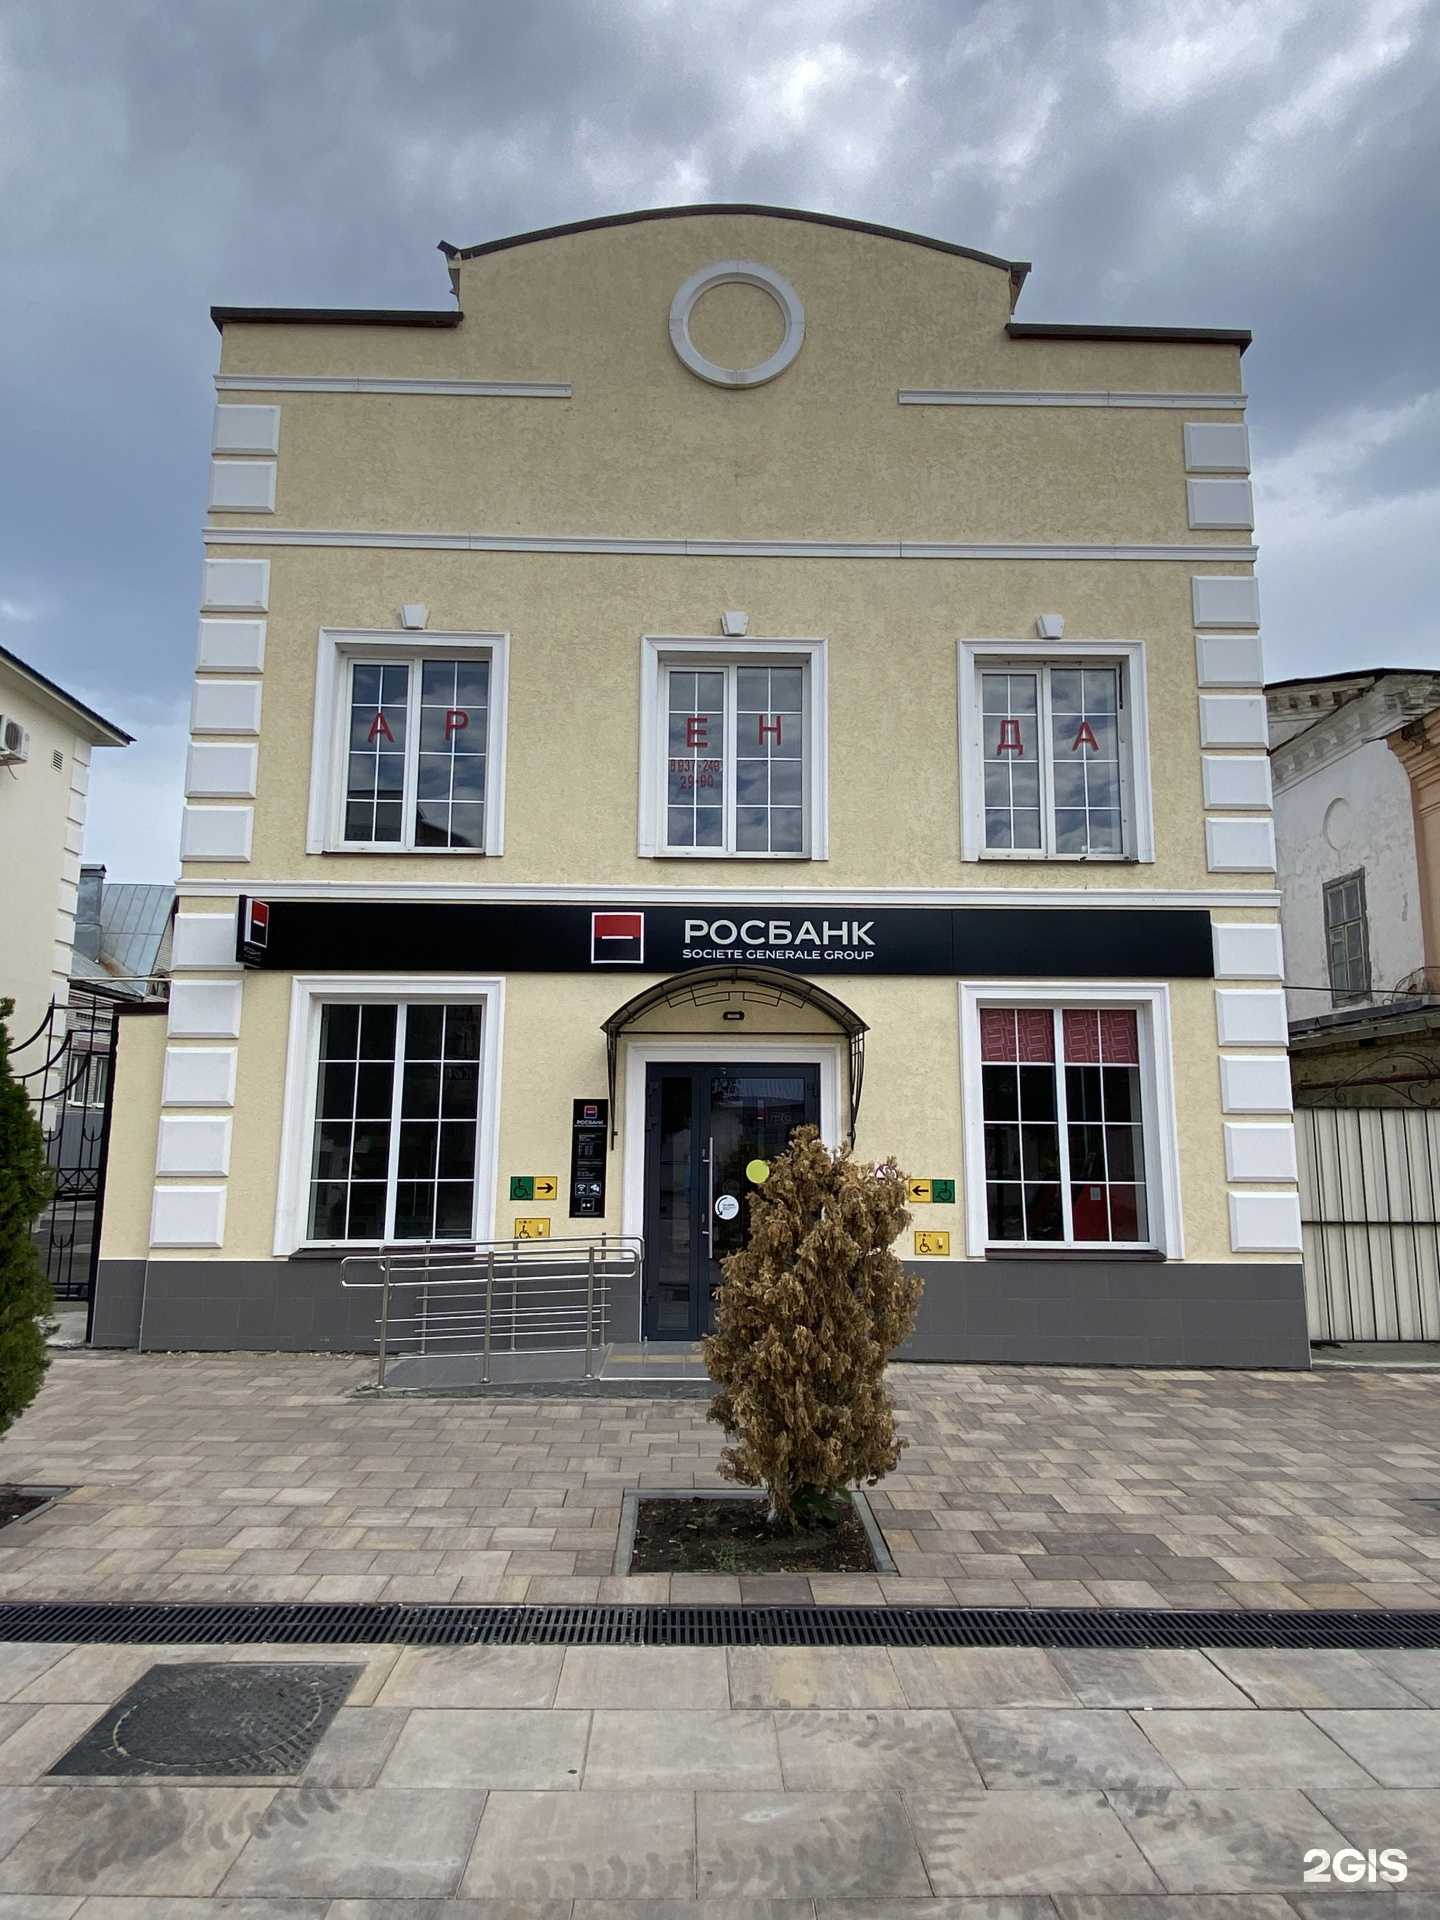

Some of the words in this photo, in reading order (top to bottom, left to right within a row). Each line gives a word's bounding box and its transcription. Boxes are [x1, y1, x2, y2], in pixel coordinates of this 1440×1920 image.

[684, 919, 877, 946] РОСБАНК
[682, 949, 743, 959] SOCIETE
[746, 950, 821, 960] GENERALE
[824, 951, 875, 961] GROUP
